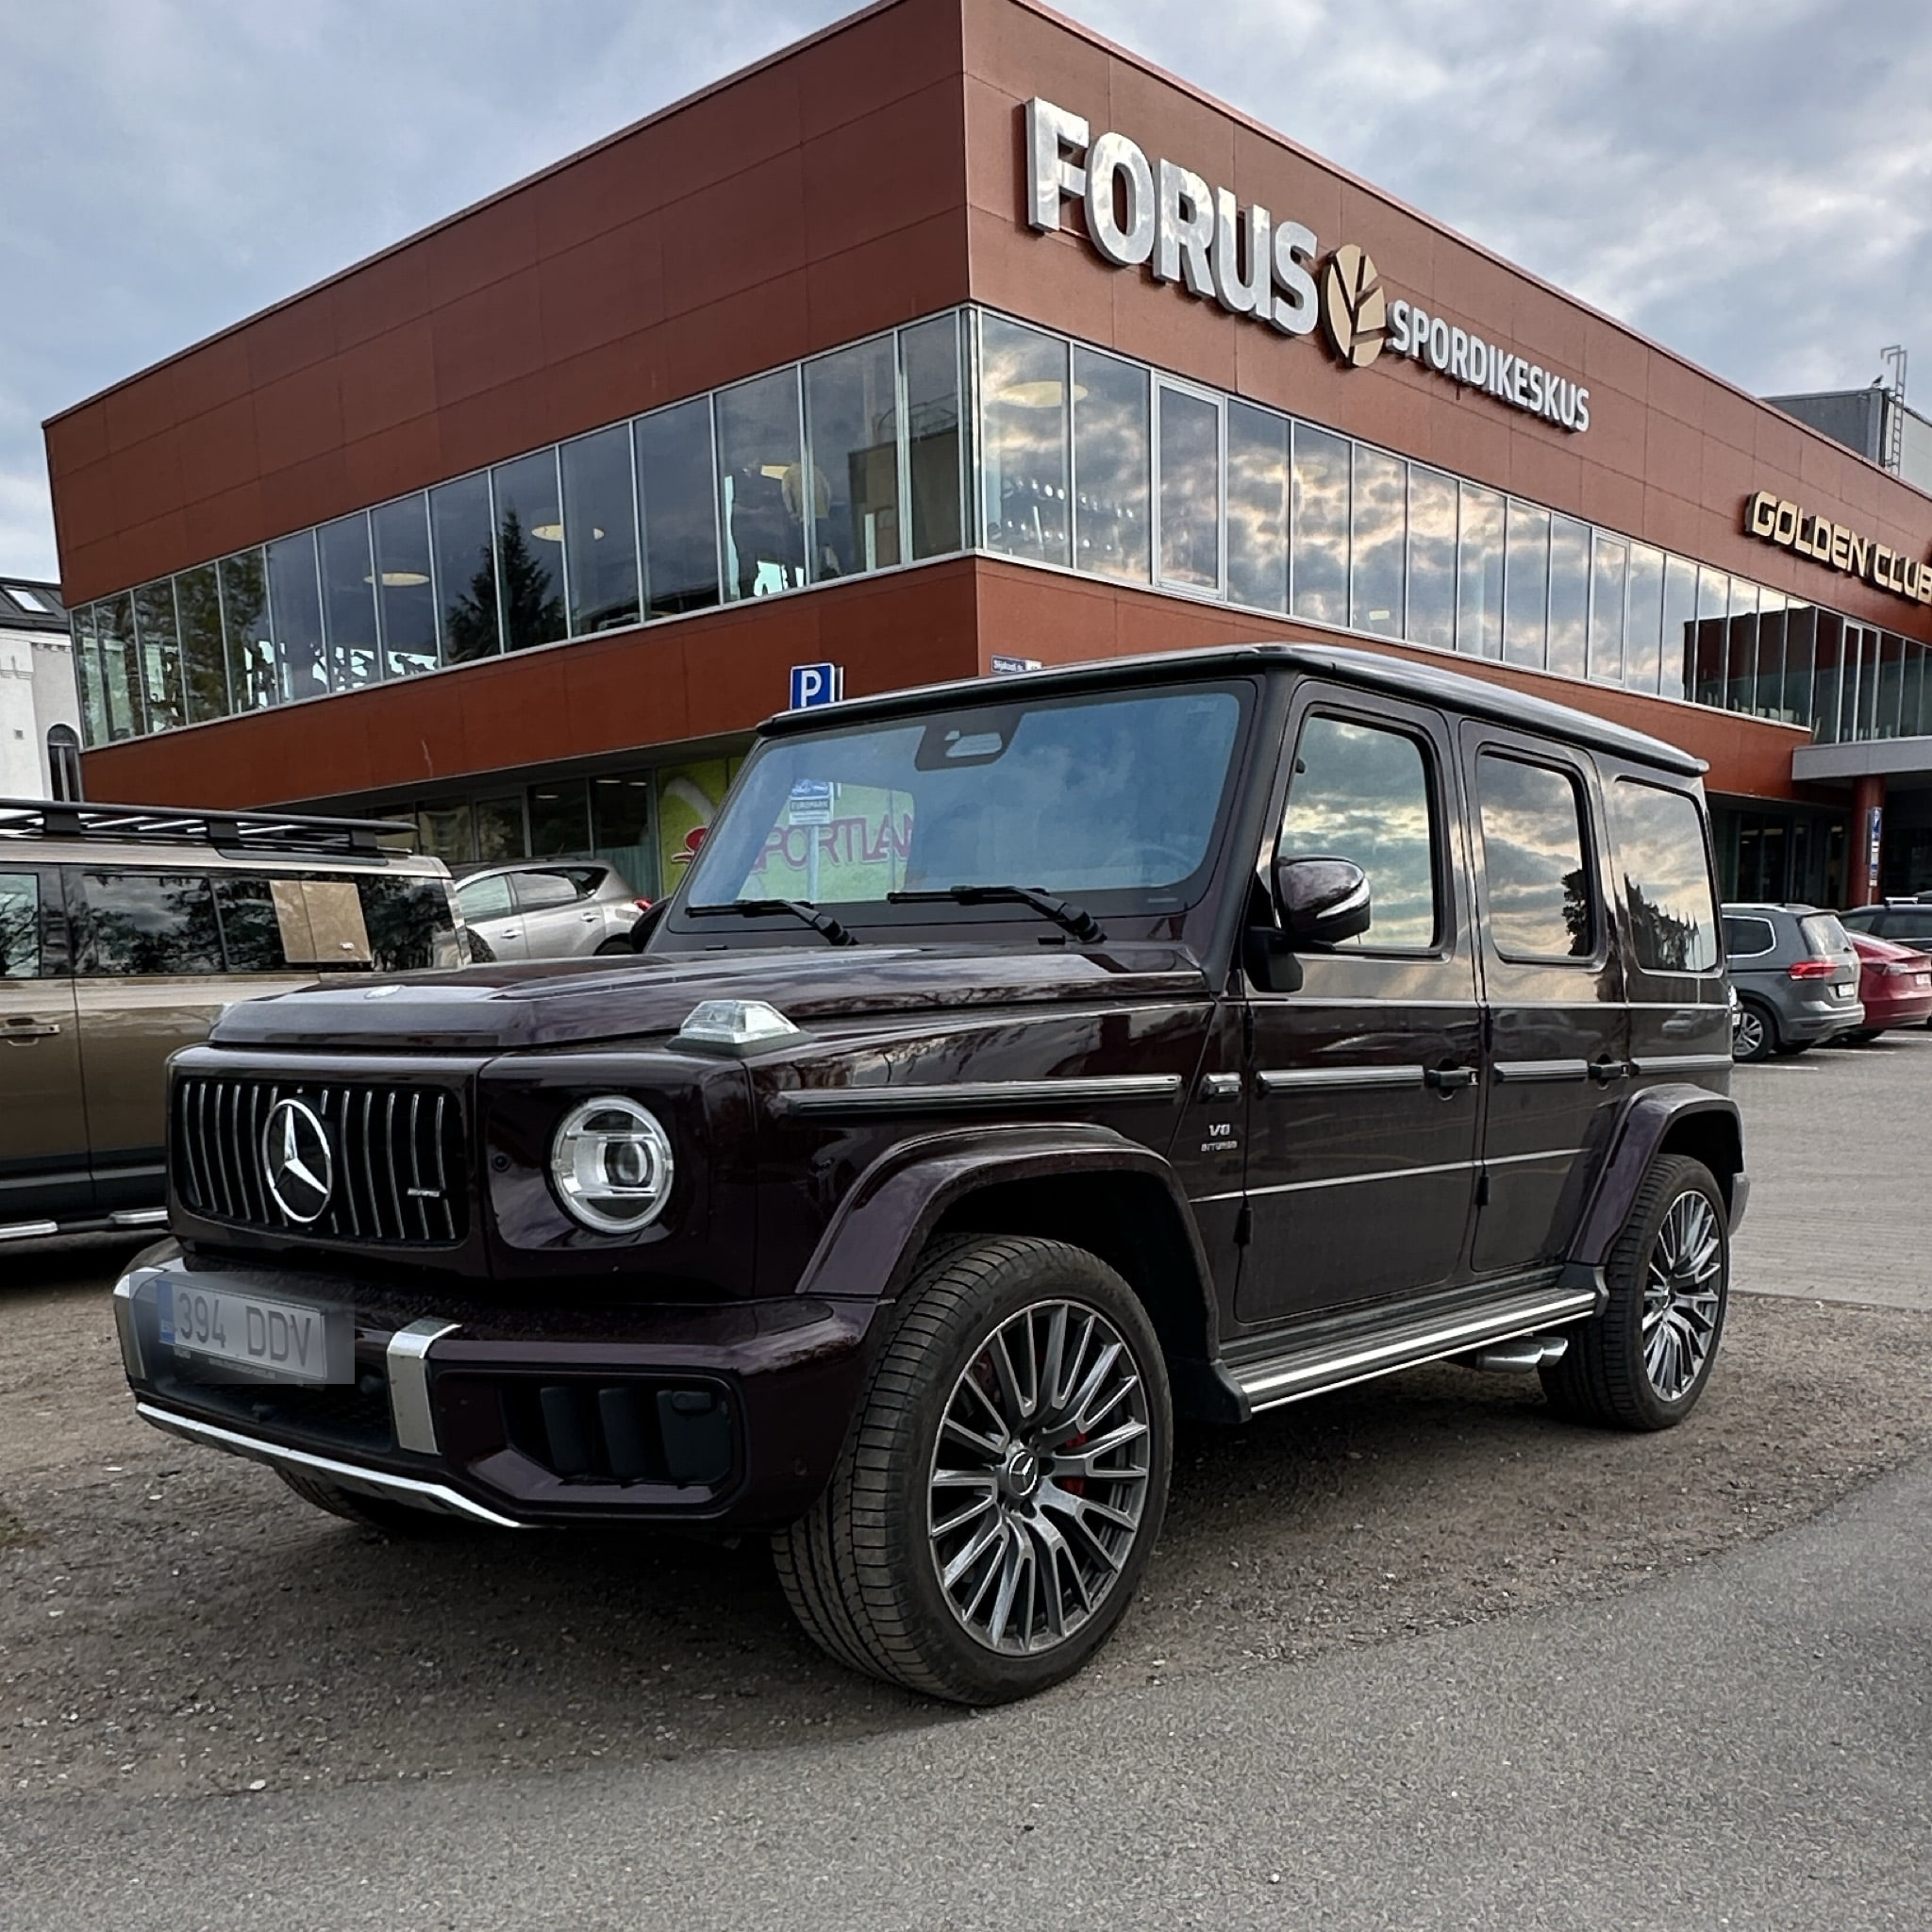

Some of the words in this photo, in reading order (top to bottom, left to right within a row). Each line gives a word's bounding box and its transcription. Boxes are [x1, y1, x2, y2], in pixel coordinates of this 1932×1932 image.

[1025, 96, 1320, 337] FORUS
[1386, 299, 1591, 433] SPORDIKESKUS
[1746, 490, 1869, 577] GOLDEN
[1870, 542, 1932, 605] CLUB
[801, 669, 822, 708] P
[178, 1292, 226, 1349] 394
[245, 1305, 311, 1367] DDV
